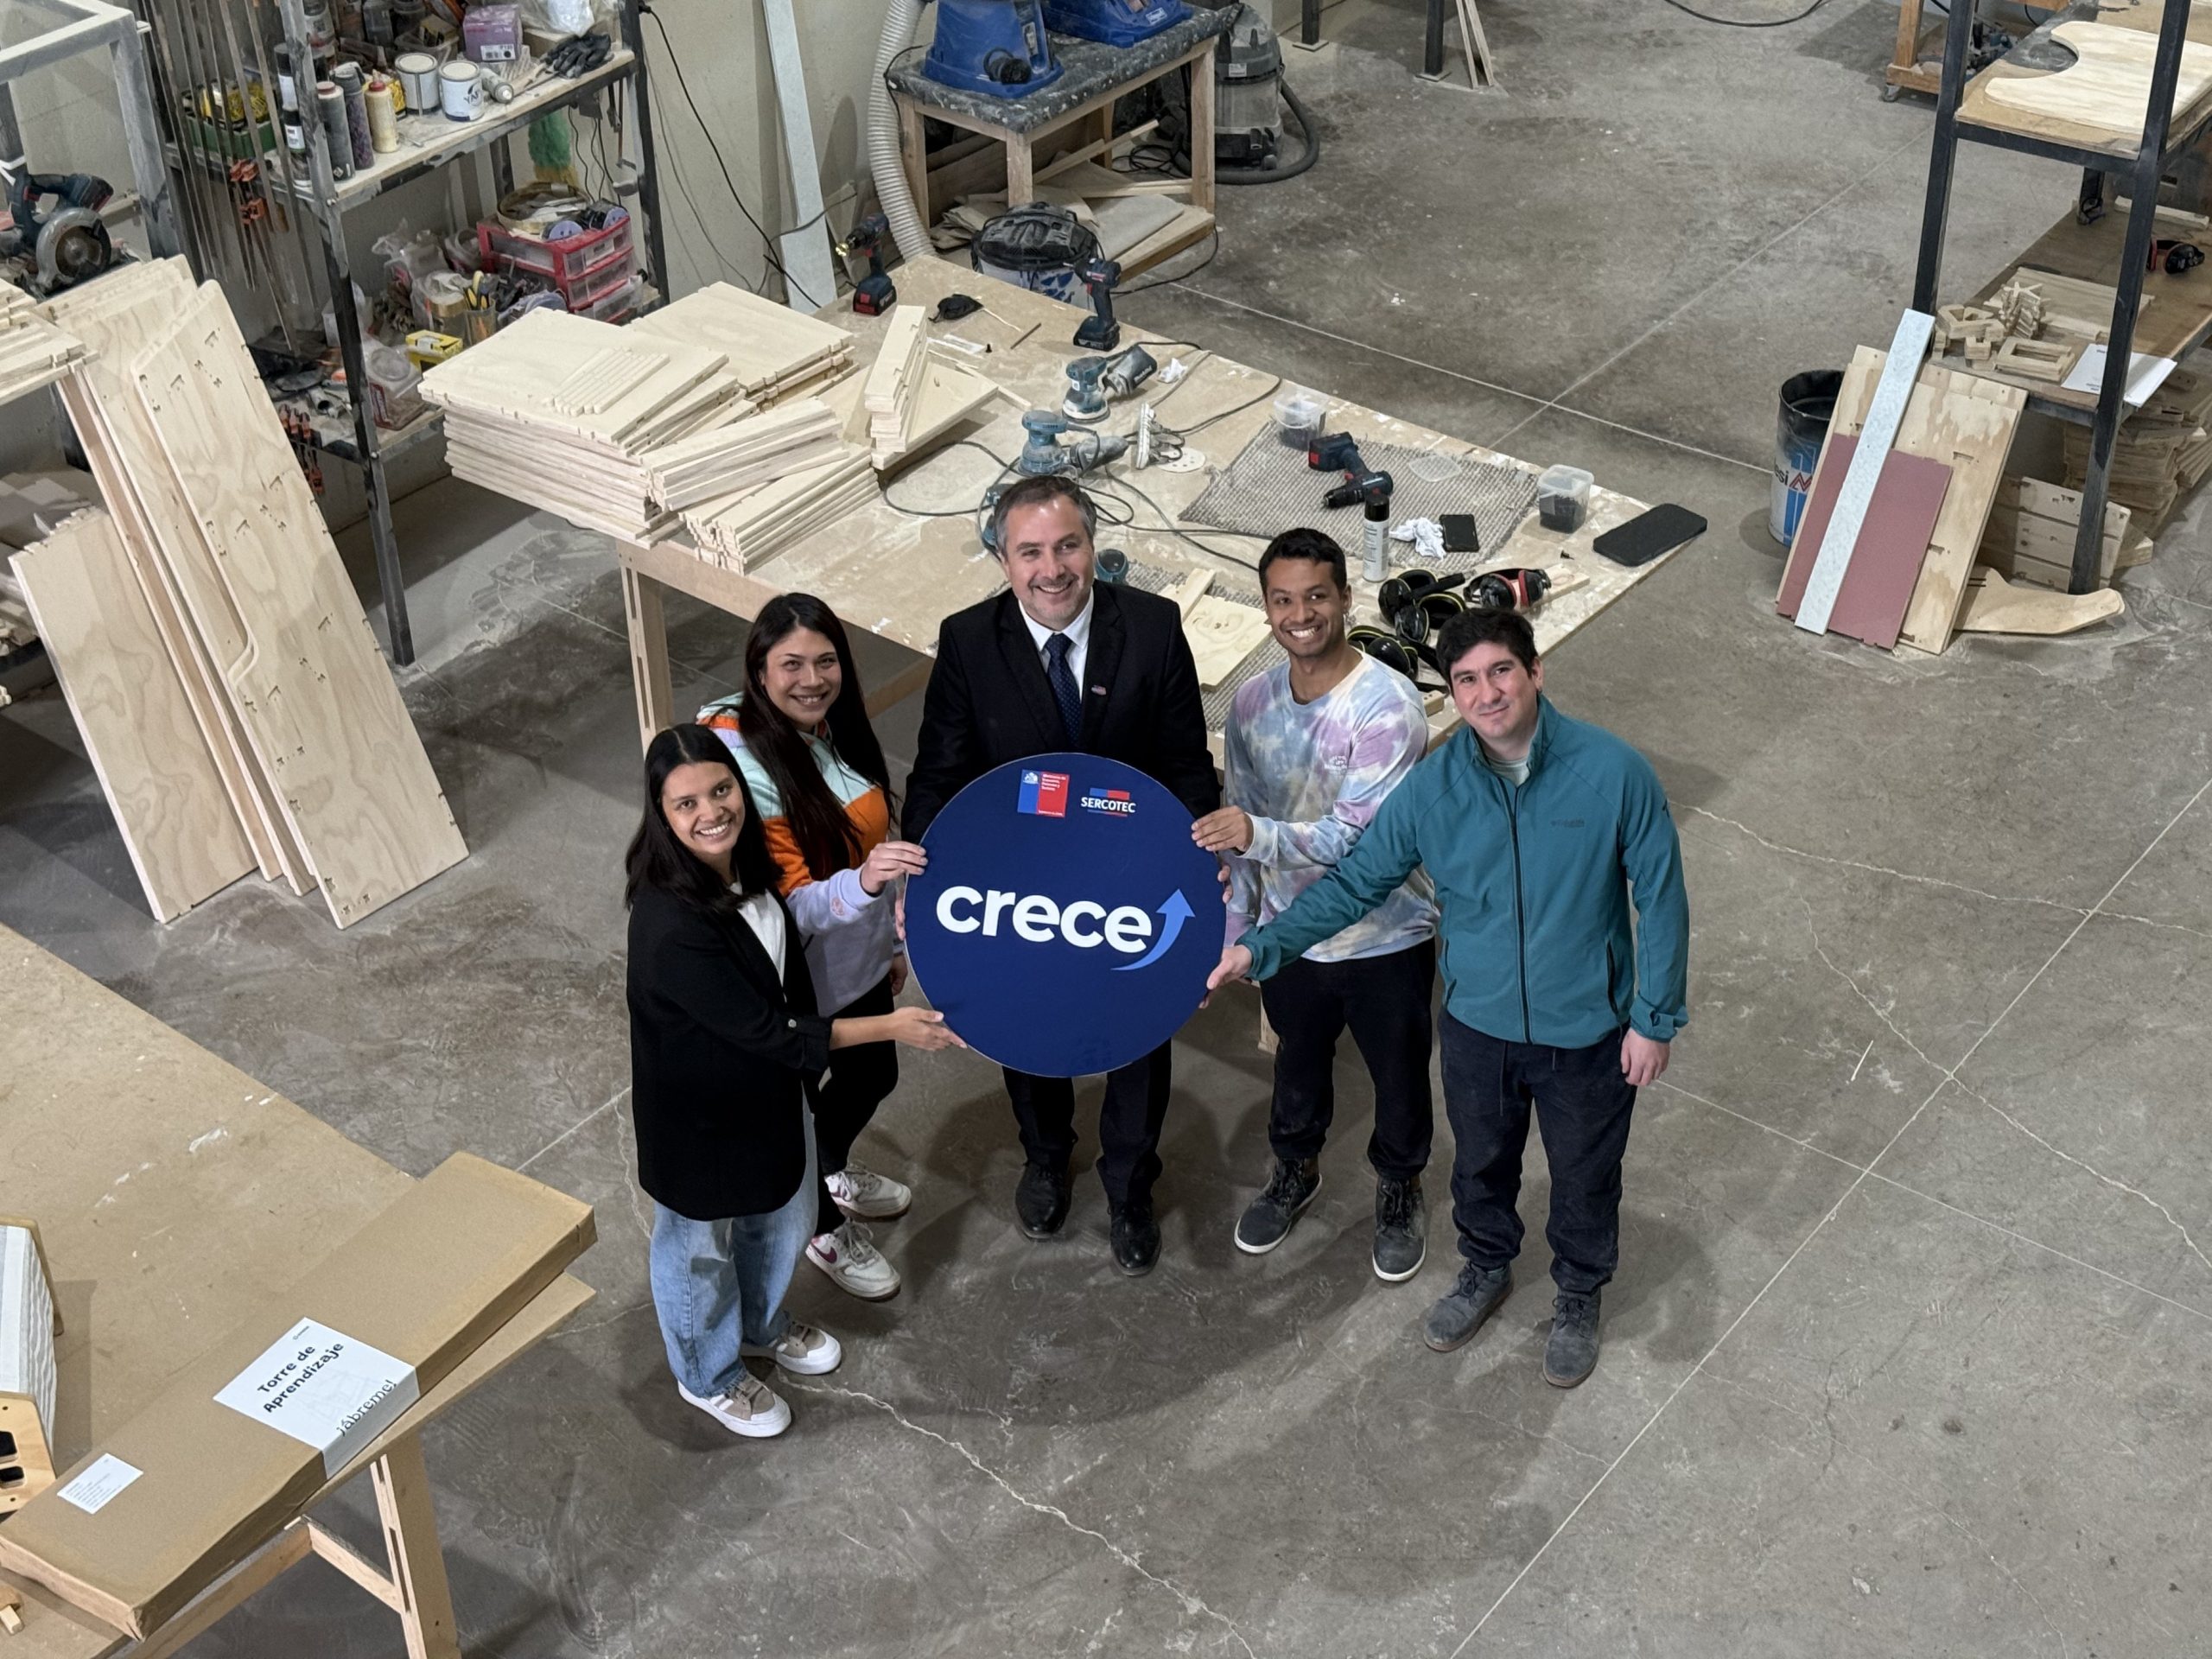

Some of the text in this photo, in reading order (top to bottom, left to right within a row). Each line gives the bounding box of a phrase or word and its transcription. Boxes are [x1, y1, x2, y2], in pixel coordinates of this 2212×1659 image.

[1080, 796, 1136, 813] SERCOTEC
[936, 885, 1153, 953] crece
[257, 1346, 315, 1393] Torre de
[263, 1343, 345, 1414] Aprendizaje
